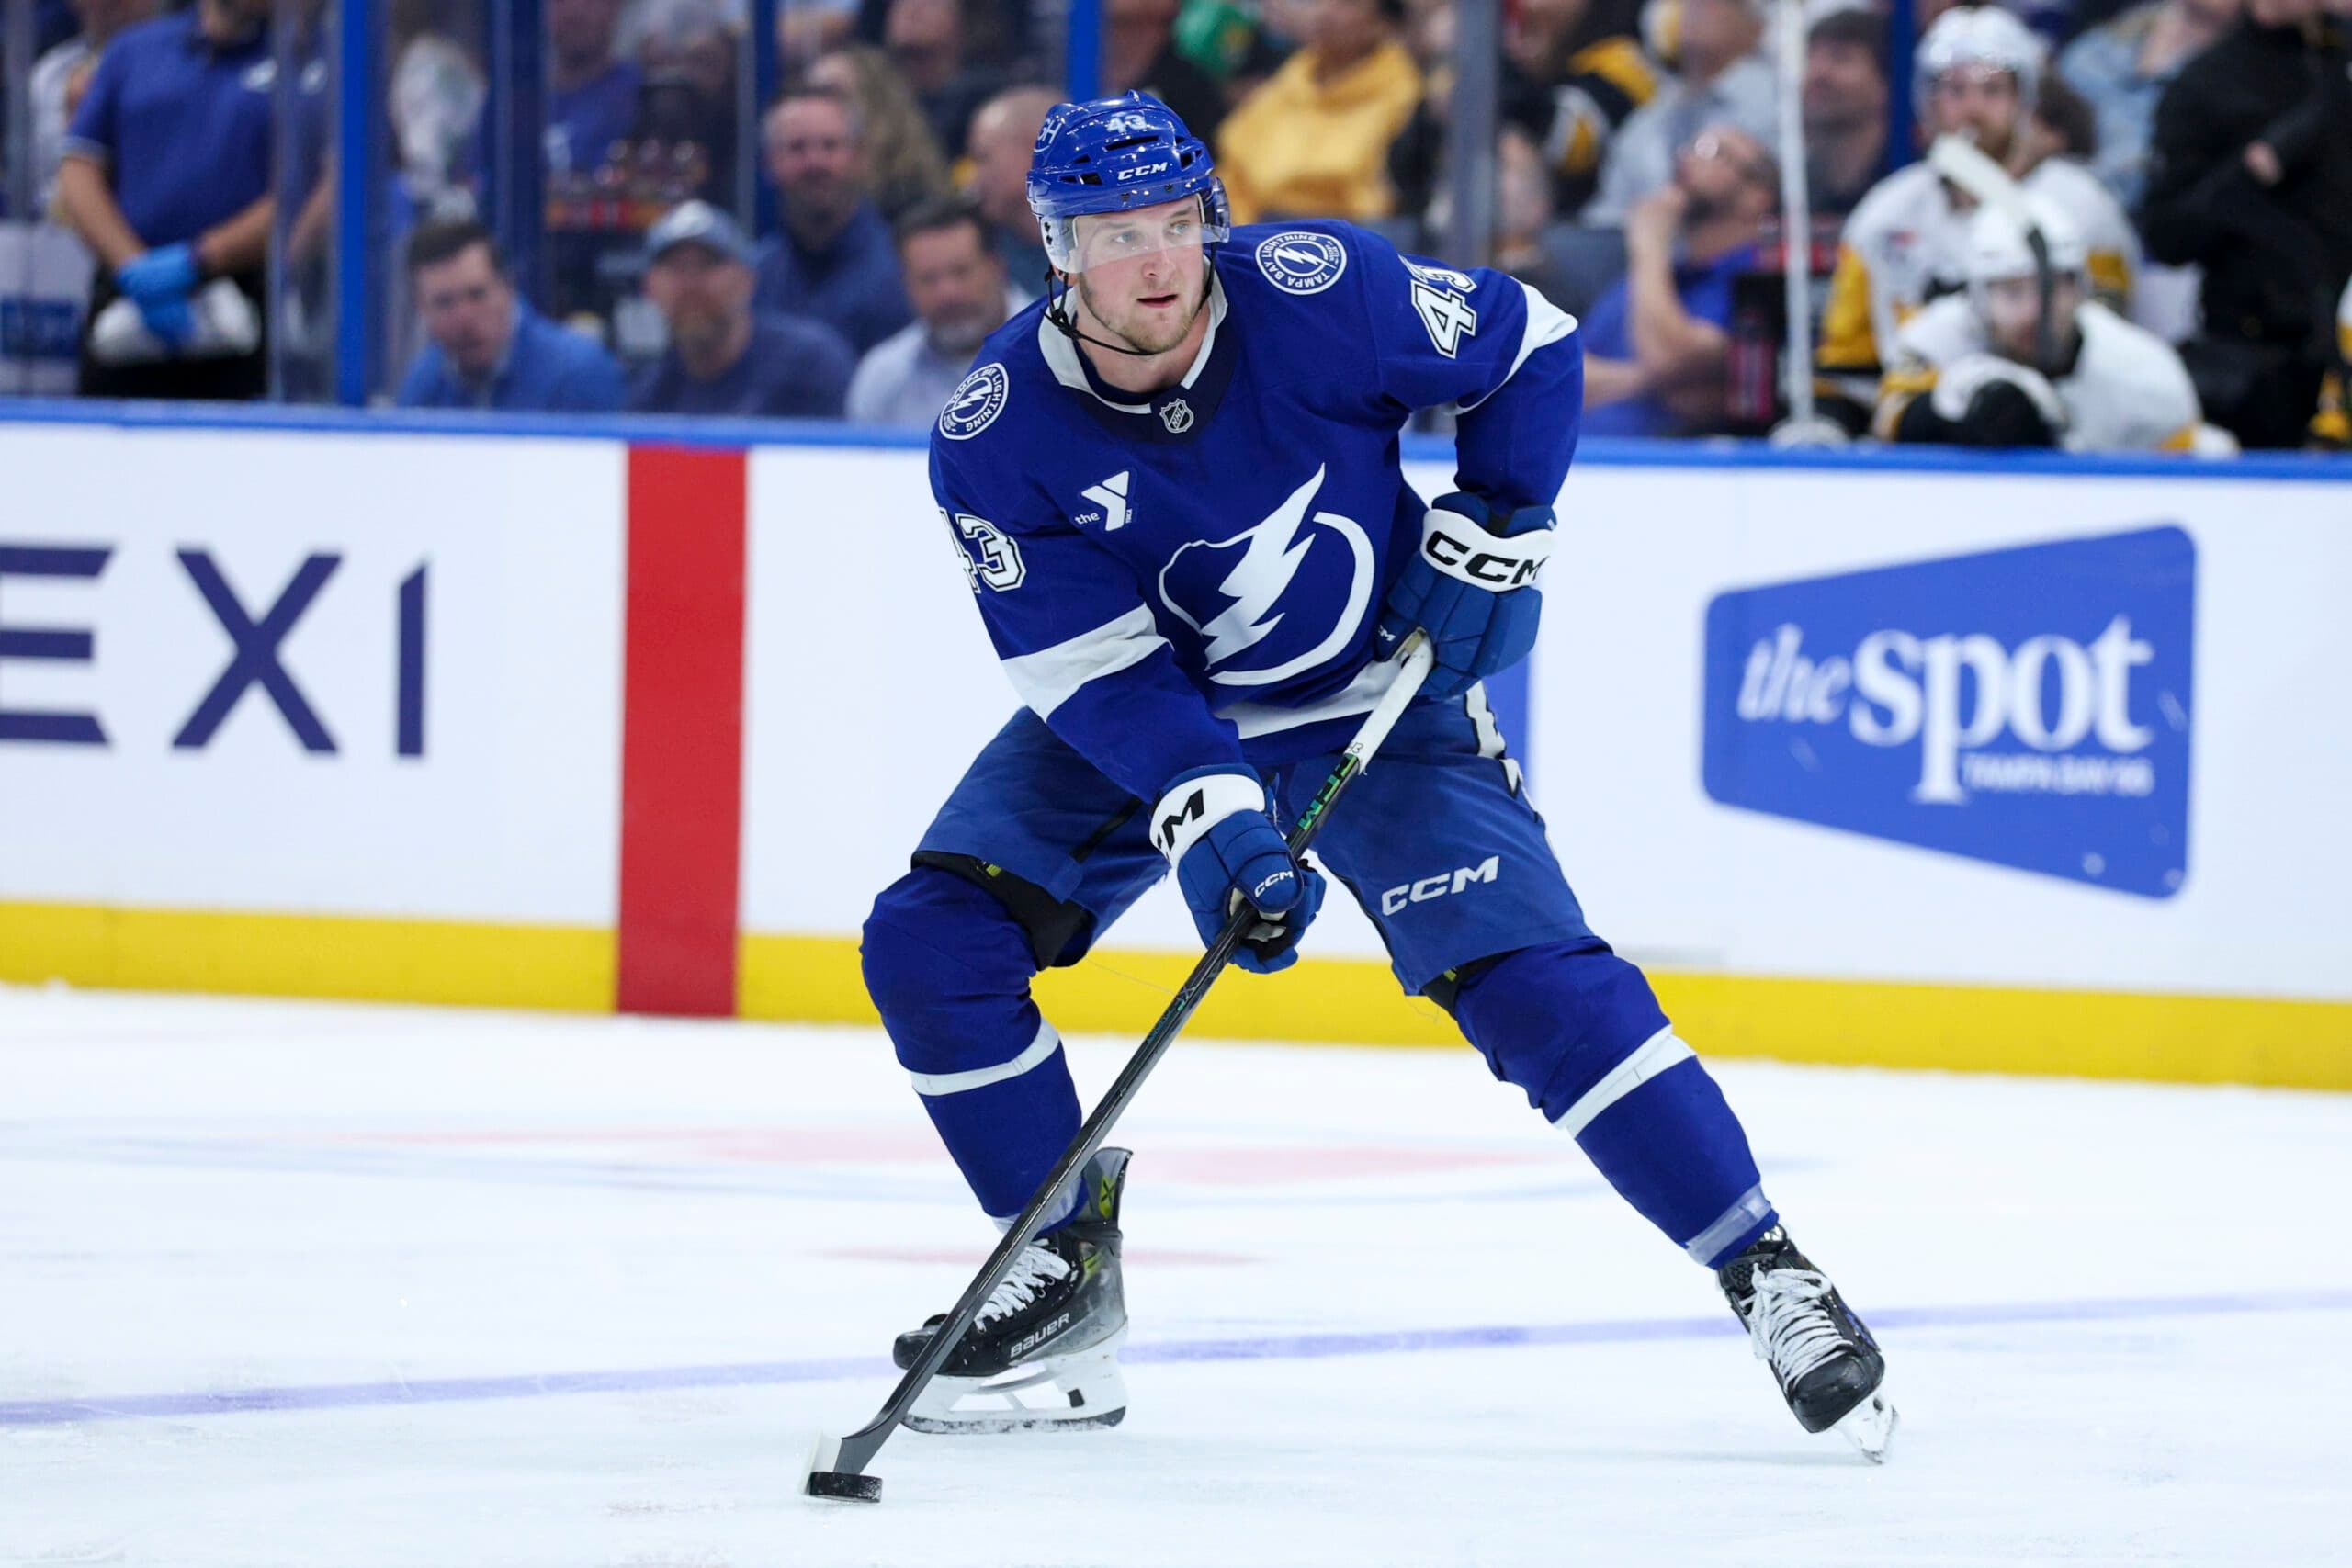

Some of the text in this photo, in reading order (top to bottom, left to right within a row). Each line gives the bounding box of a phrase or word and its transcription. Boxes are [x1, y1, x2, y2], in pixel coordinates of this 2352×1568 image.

[1106, 113, 1148, 133] 43
[1117, 162, 1168, 181] CCM
[1261, 234, 1317, 258] LIGHTNING
[1263, 261, 1285, 280] BAY
[1288, 271, 1330, 288] TAMPA
[966, 373, 1002, 432] LIGHTNING
[1074, 513, 1101, 525] the
[939, 507, 1027, 594] 3
[1426, 530, 1550, 585] CCM
[1254, 870, 1295, 897] CCM
[1382, 855, 1499, 917] CCM
